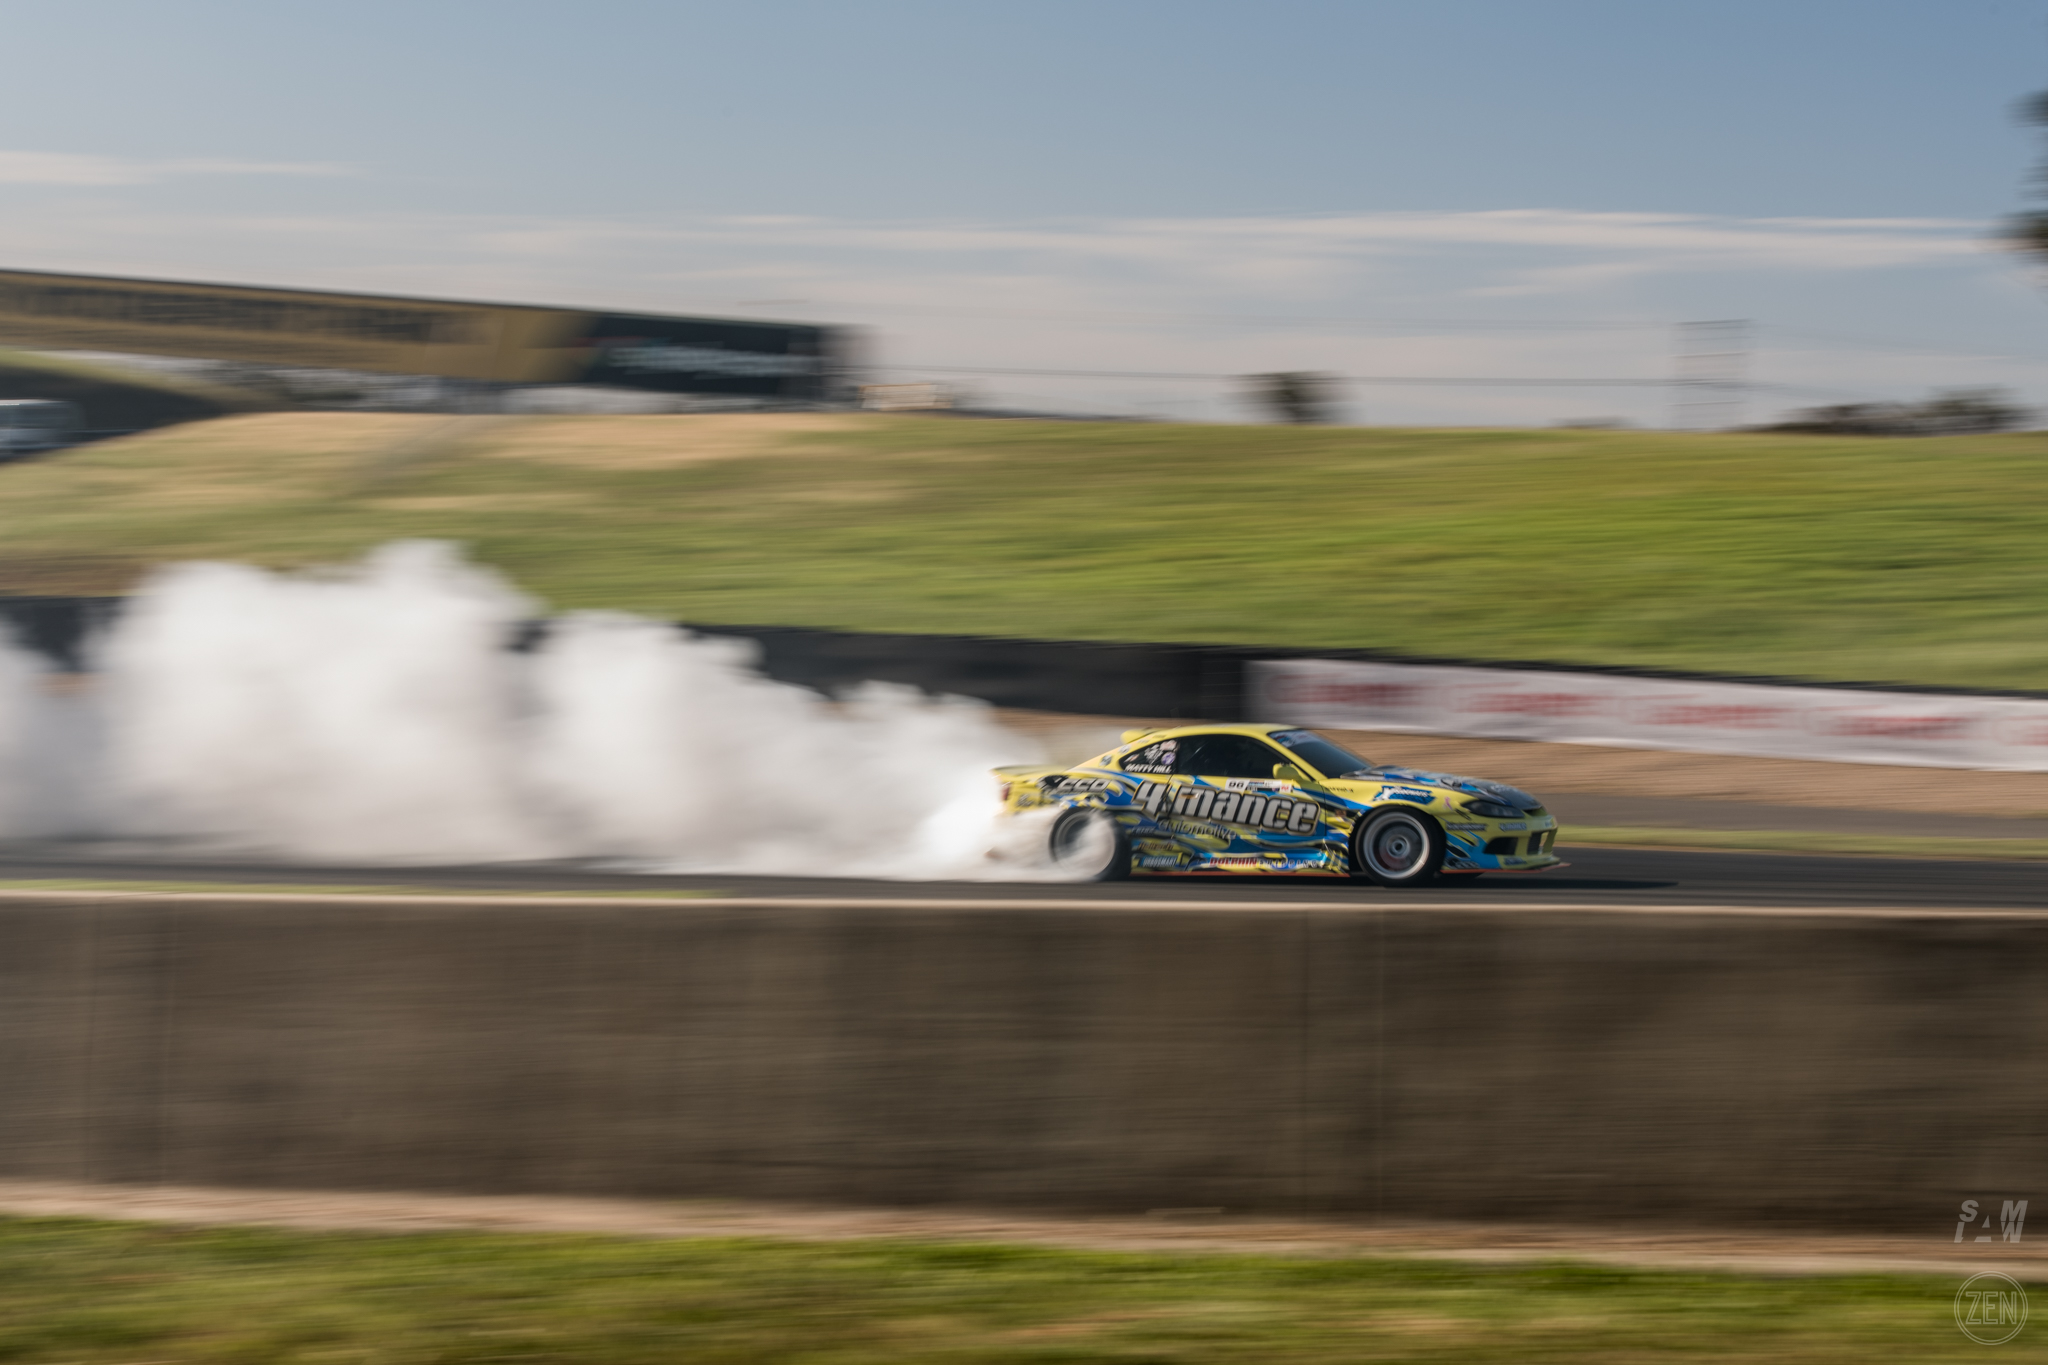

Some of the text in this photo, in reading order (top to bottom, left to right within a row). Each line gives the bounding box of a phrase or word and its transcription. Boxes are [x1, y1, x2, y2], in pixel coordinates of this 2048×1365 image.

[1124, 764, 1172, 774] MATTY HILL
[1210, 857, 1257, 867] DOLPHIN
